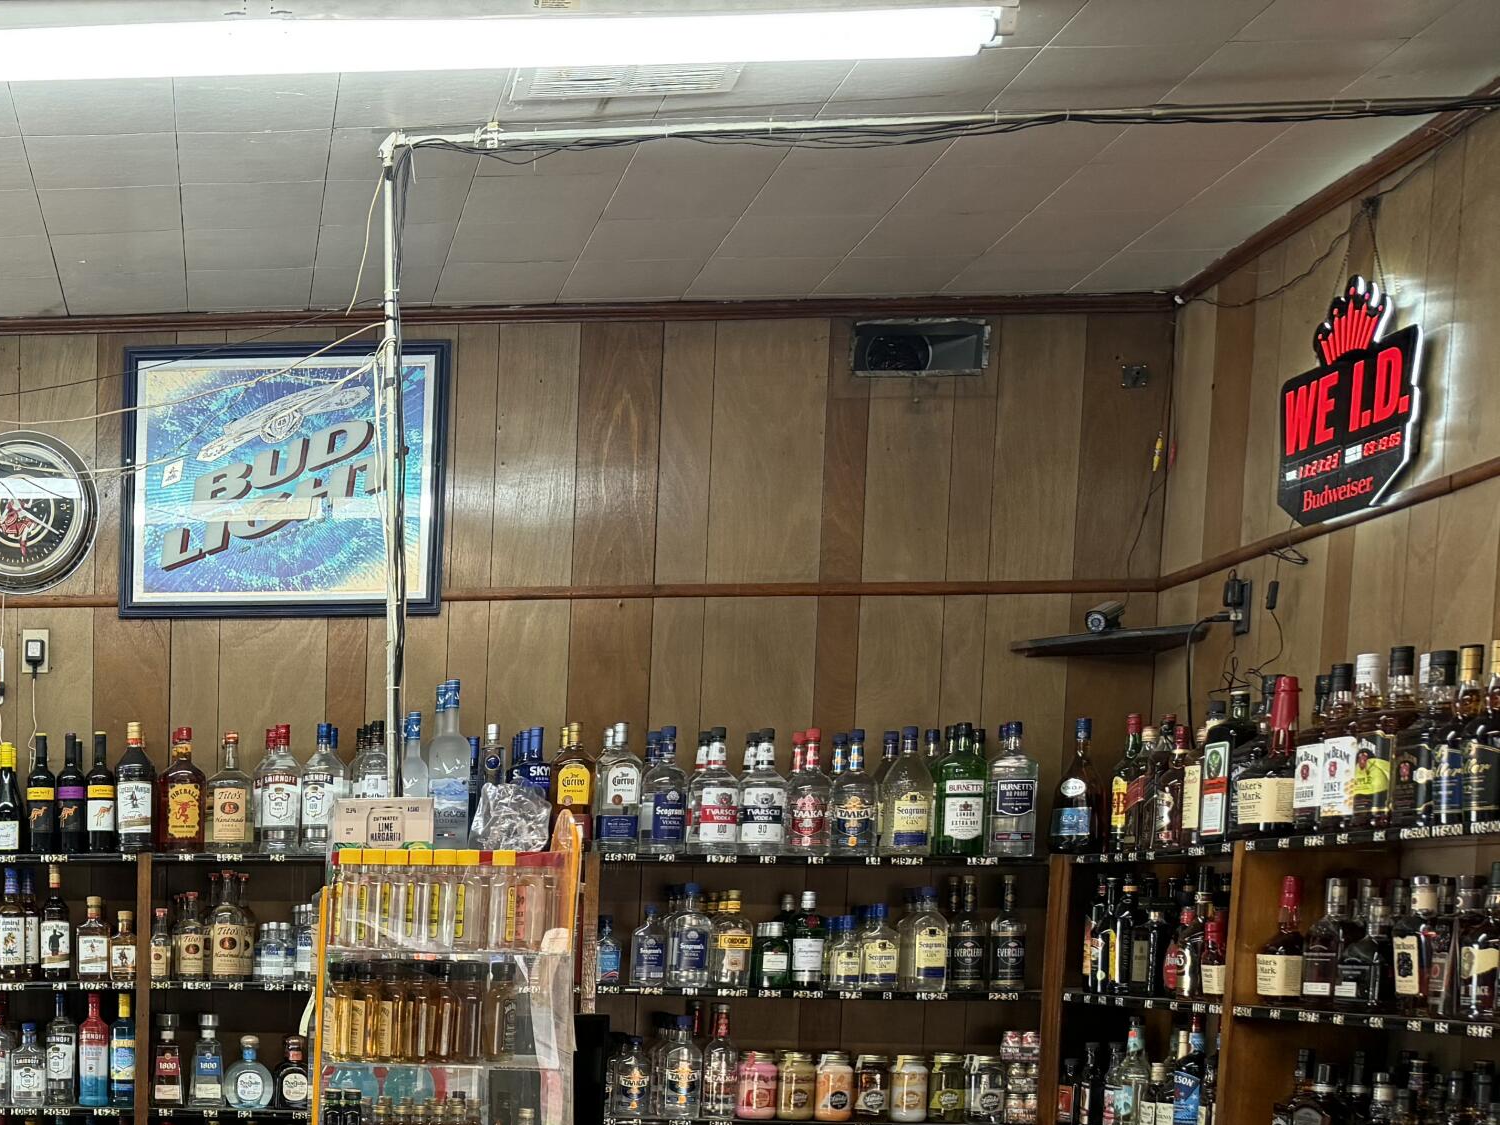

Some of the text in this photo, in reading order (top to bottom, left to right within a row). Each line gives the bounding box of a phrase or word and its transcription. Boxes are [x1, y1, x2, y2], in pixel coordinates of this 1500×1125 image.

[1285, 347, 1409, 456] WE I.D.
[190, 420, 376, 517] BUD
[1302, 476, 1374, 512] Budweiser
[562, 776, 585, 787] Cuervo
[612, 776, 635, 787] Cuervo
[171, 784, 200, 799] FIREBALL
[948, 784, 983, 792] BURNETT'S
[1000, 783, 1034, 791] BURNETT'S
[216, 790, 243, 800] Tito's
[656, 806, 685, 816] Seagram's
[378, 822, 394, 832] LIME
[716, 824, 727, 834] 100
[757, 824, 768, 834] 90
[370, 832, 401, 842] MARGARITA
[122, 854, 136, 862] 35
[217, 926, 240, 936] Tito's
[229, 982, 243, 990] 28
[159, 1061, 177, 1070] 1800
[199, 1061, 217, 1070] 1800
[44, 1108, 70, 1116] 2050
